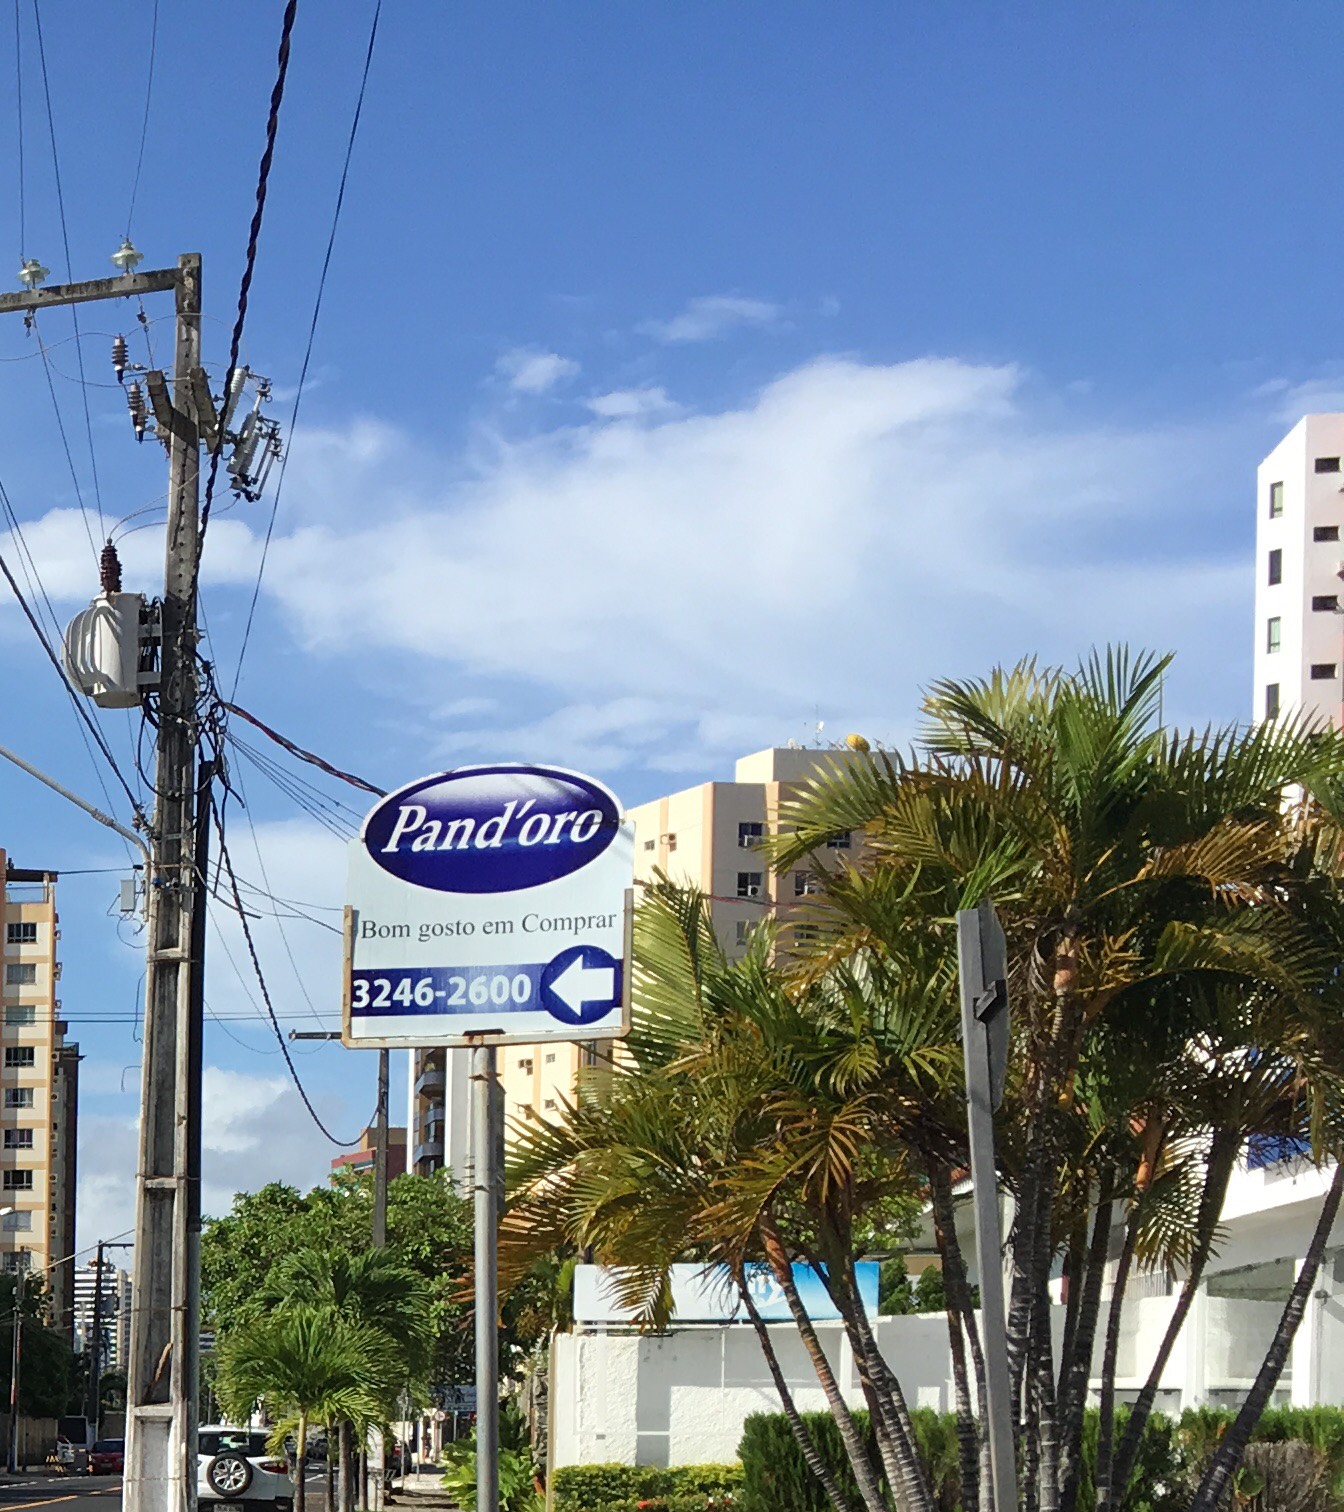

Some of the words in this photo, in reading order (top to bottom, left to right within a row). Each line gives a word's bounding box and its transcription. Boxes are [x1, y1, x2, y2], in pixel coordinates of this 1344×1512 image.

[381, 798, 604, 854] Pand'oro
[360, 919, 411, 940] Bom
[418, 918, 475, 942] gosto
[482, 918, 514, 935] em
[522, 912, 617, 939] Comprar
[352, 974, 532, 1009] 3246-2600
